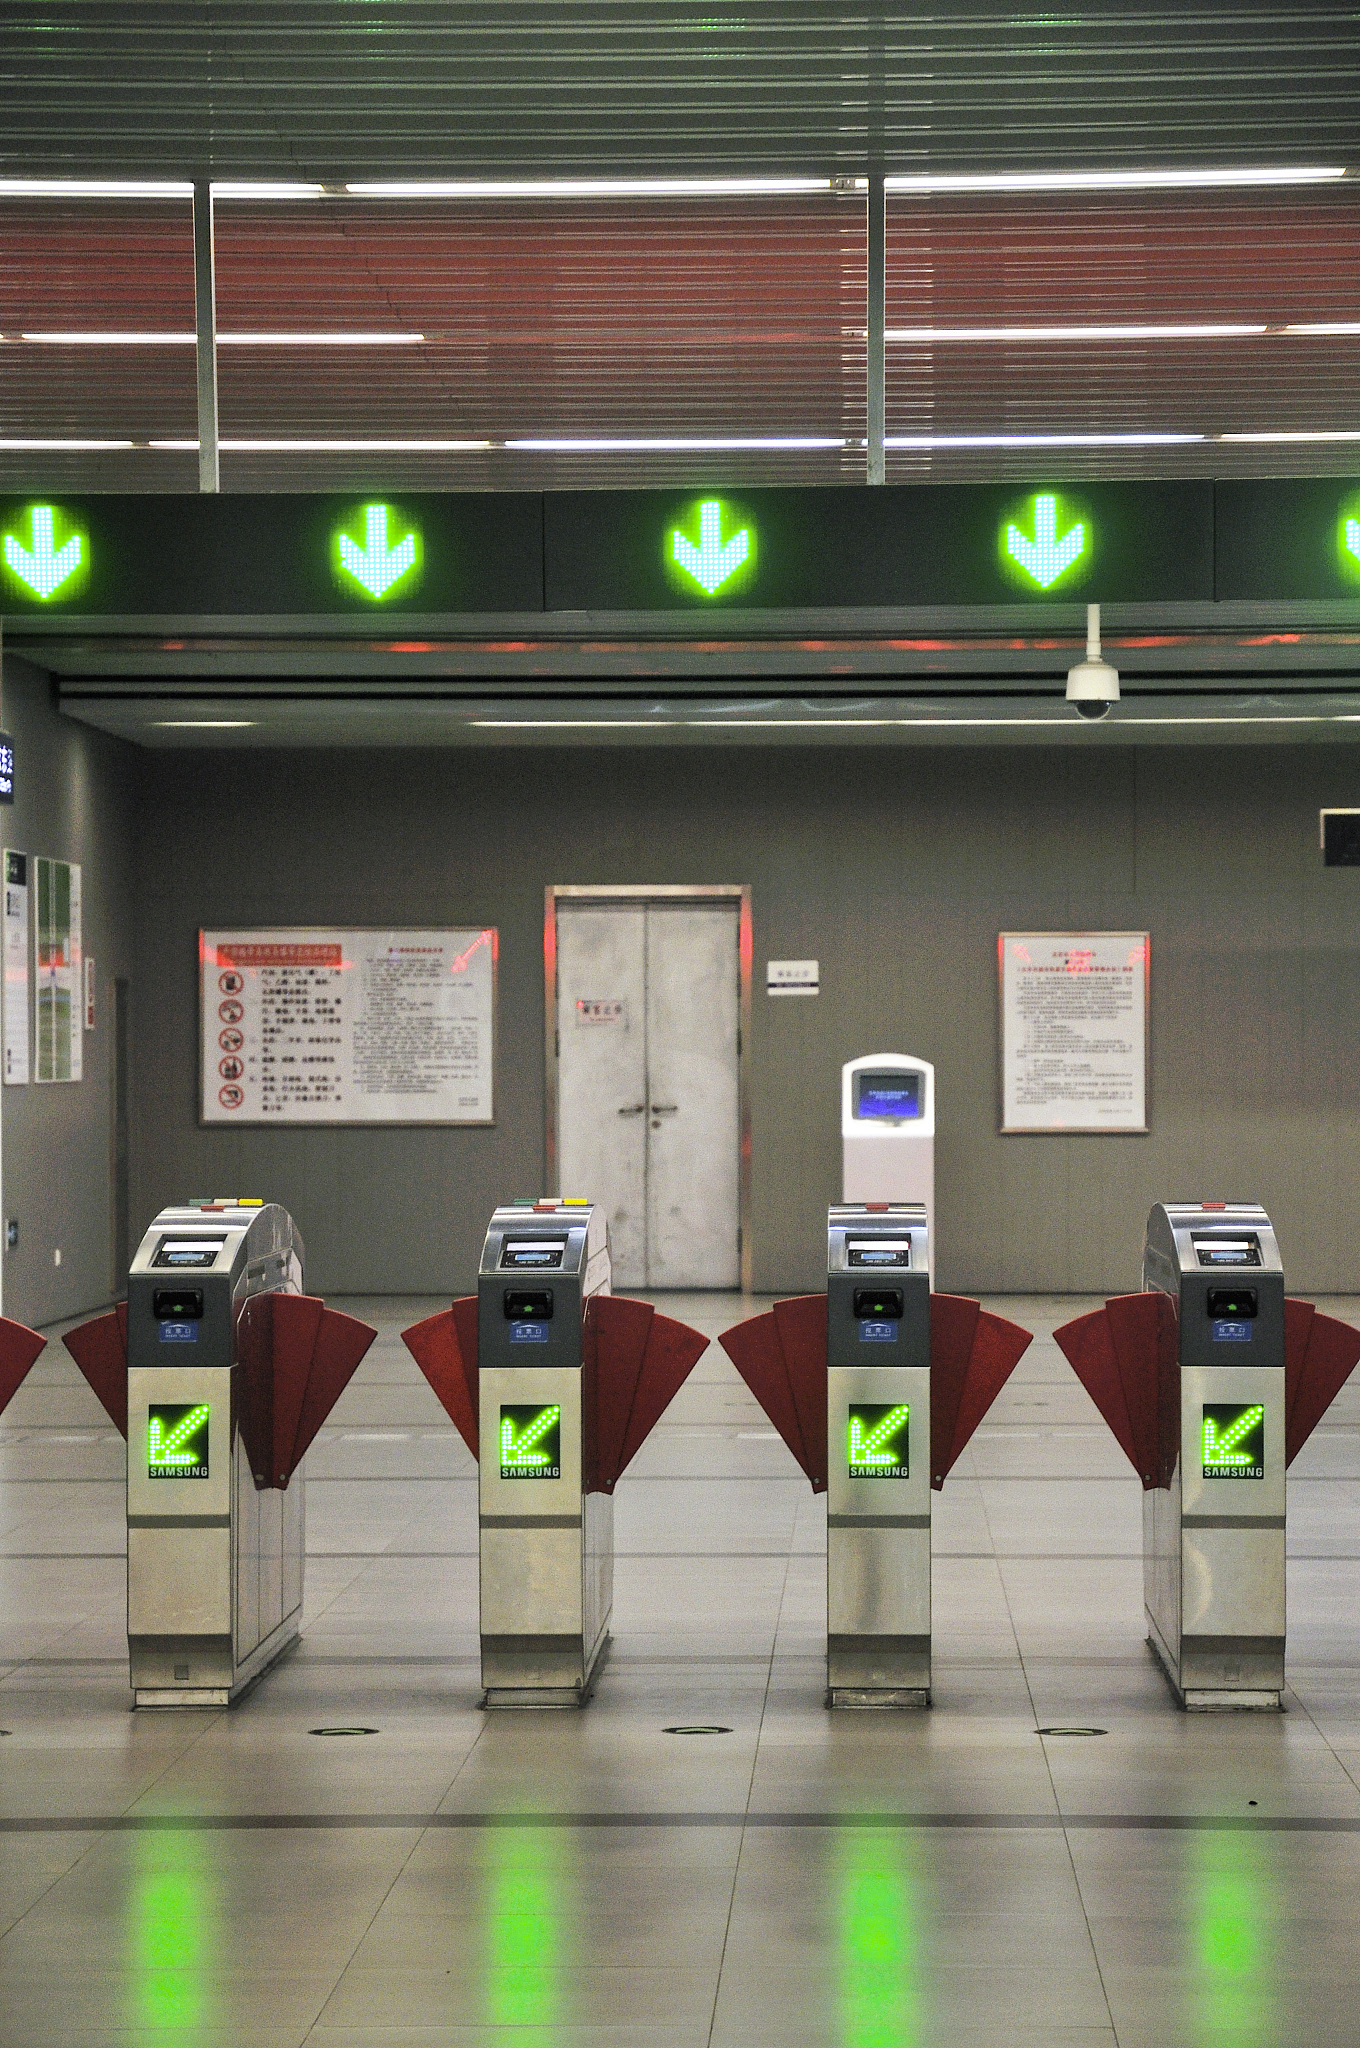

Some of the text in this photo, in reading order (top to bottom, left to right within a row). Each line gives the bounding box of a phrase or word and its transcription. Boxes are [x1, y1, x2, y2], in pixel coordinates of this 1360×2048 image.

[150, 1466, 208, 1477] SAMSUNG
[502, 1467, 560, 1477] SAMSUNG
[850, 1466, 909, 1477] SAMSUNG
[1204, 1467, 1263, 1477] SAMSUNG
